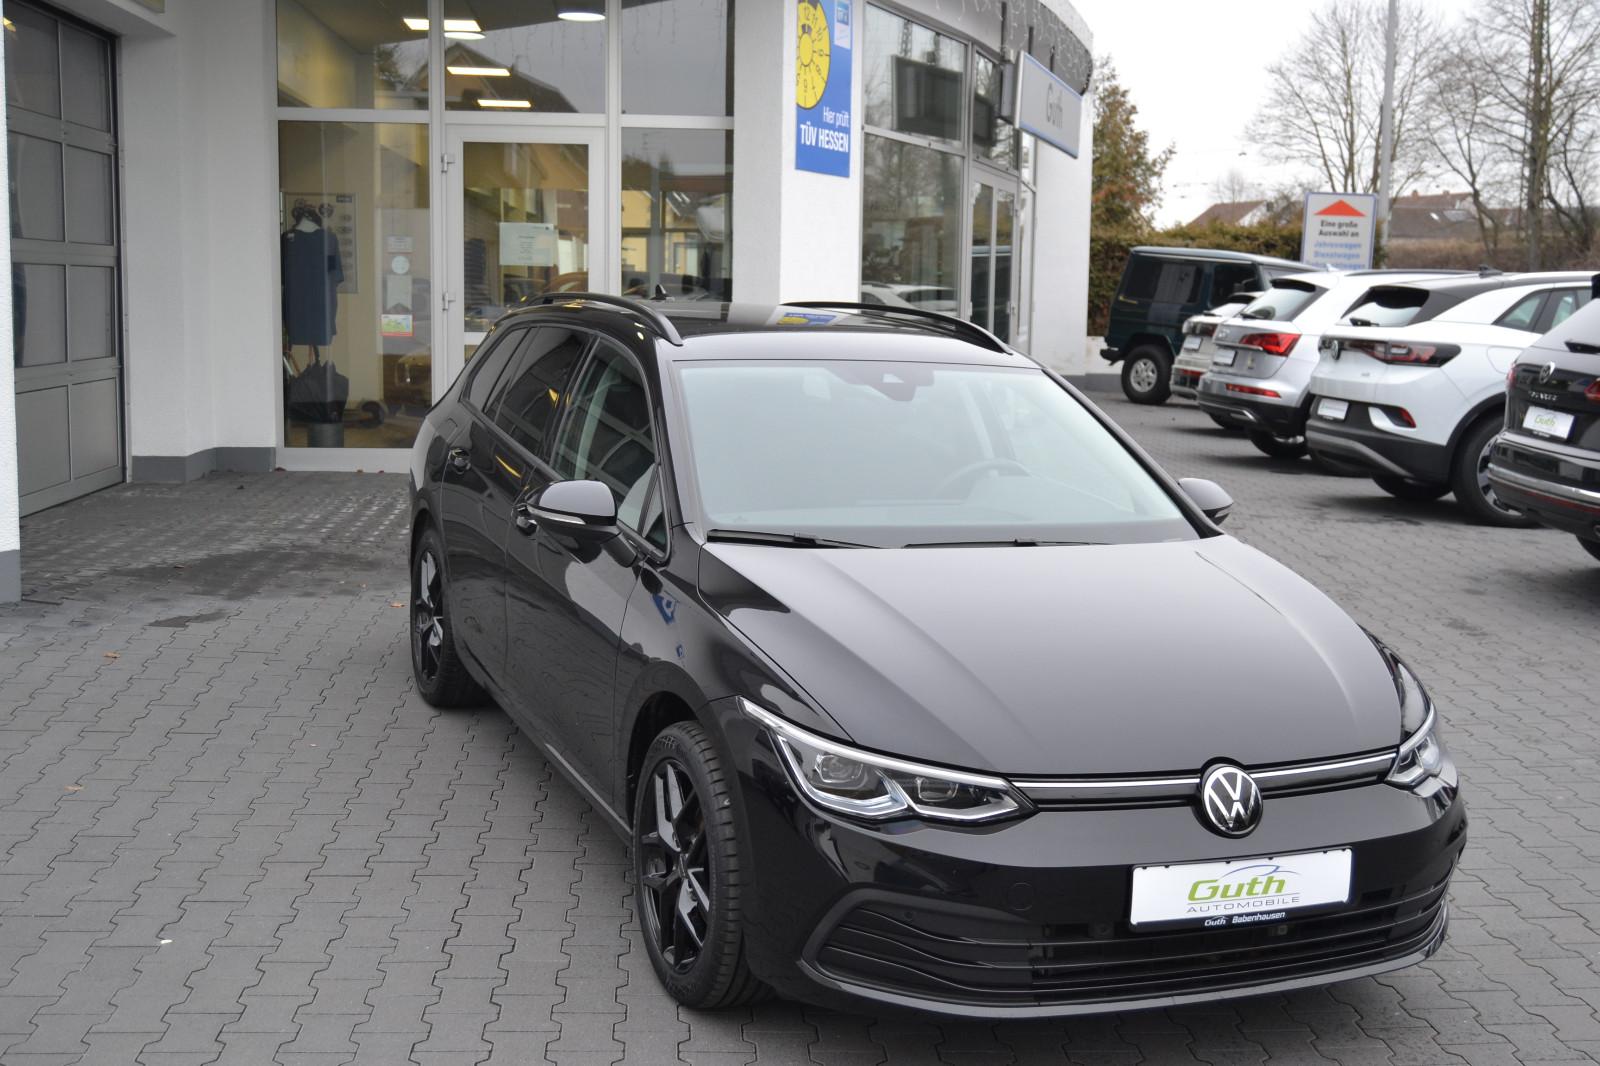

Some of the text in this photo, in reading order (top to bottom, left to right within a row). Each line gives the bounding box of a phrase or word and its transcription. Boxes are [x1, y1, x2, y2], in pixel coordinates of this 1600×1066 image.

[823, 106, 834, 124] Hier
[800, 120, 849, 153] TÜV HESSEN
[1187, 876, 1286, 902] Guth
[1187, 897, 1300, 914] AUTOMOBILE
[1204, 912, 1286, 927] Guth Babenhausen
